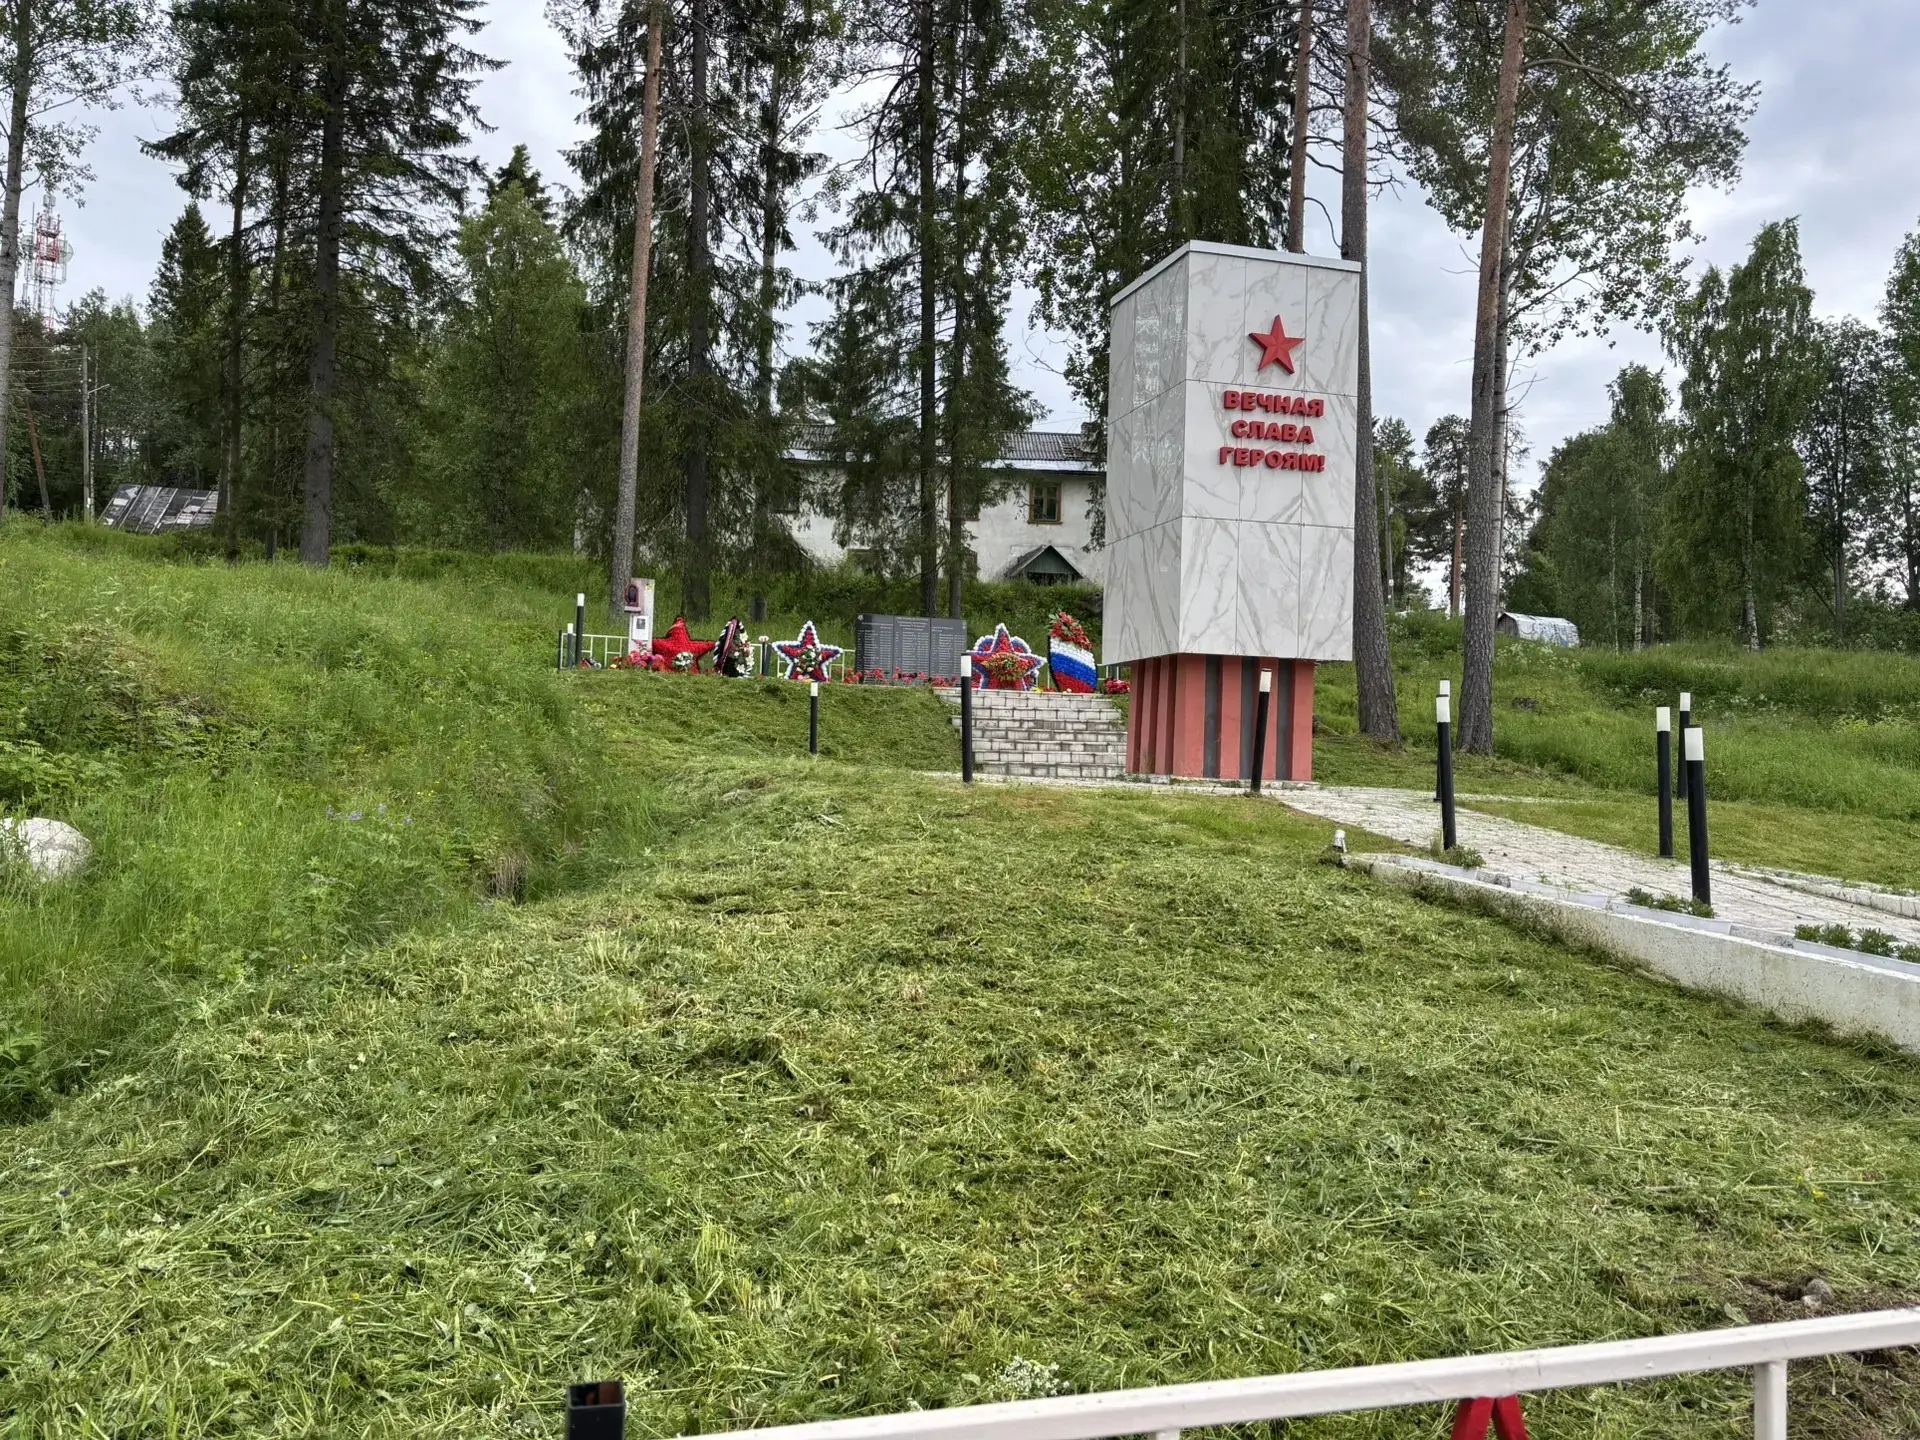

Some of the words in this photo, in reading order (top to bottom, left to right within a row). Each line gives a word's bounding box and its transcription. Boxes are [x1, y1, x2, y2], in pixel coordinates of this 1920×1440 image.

[1224, 390, 1324, 417] ВЕЧНАЯ
[1231, 419, 1314, 444] СЛАВА
[1219, 446, 1325, 473] ГЕРОЯМ!
